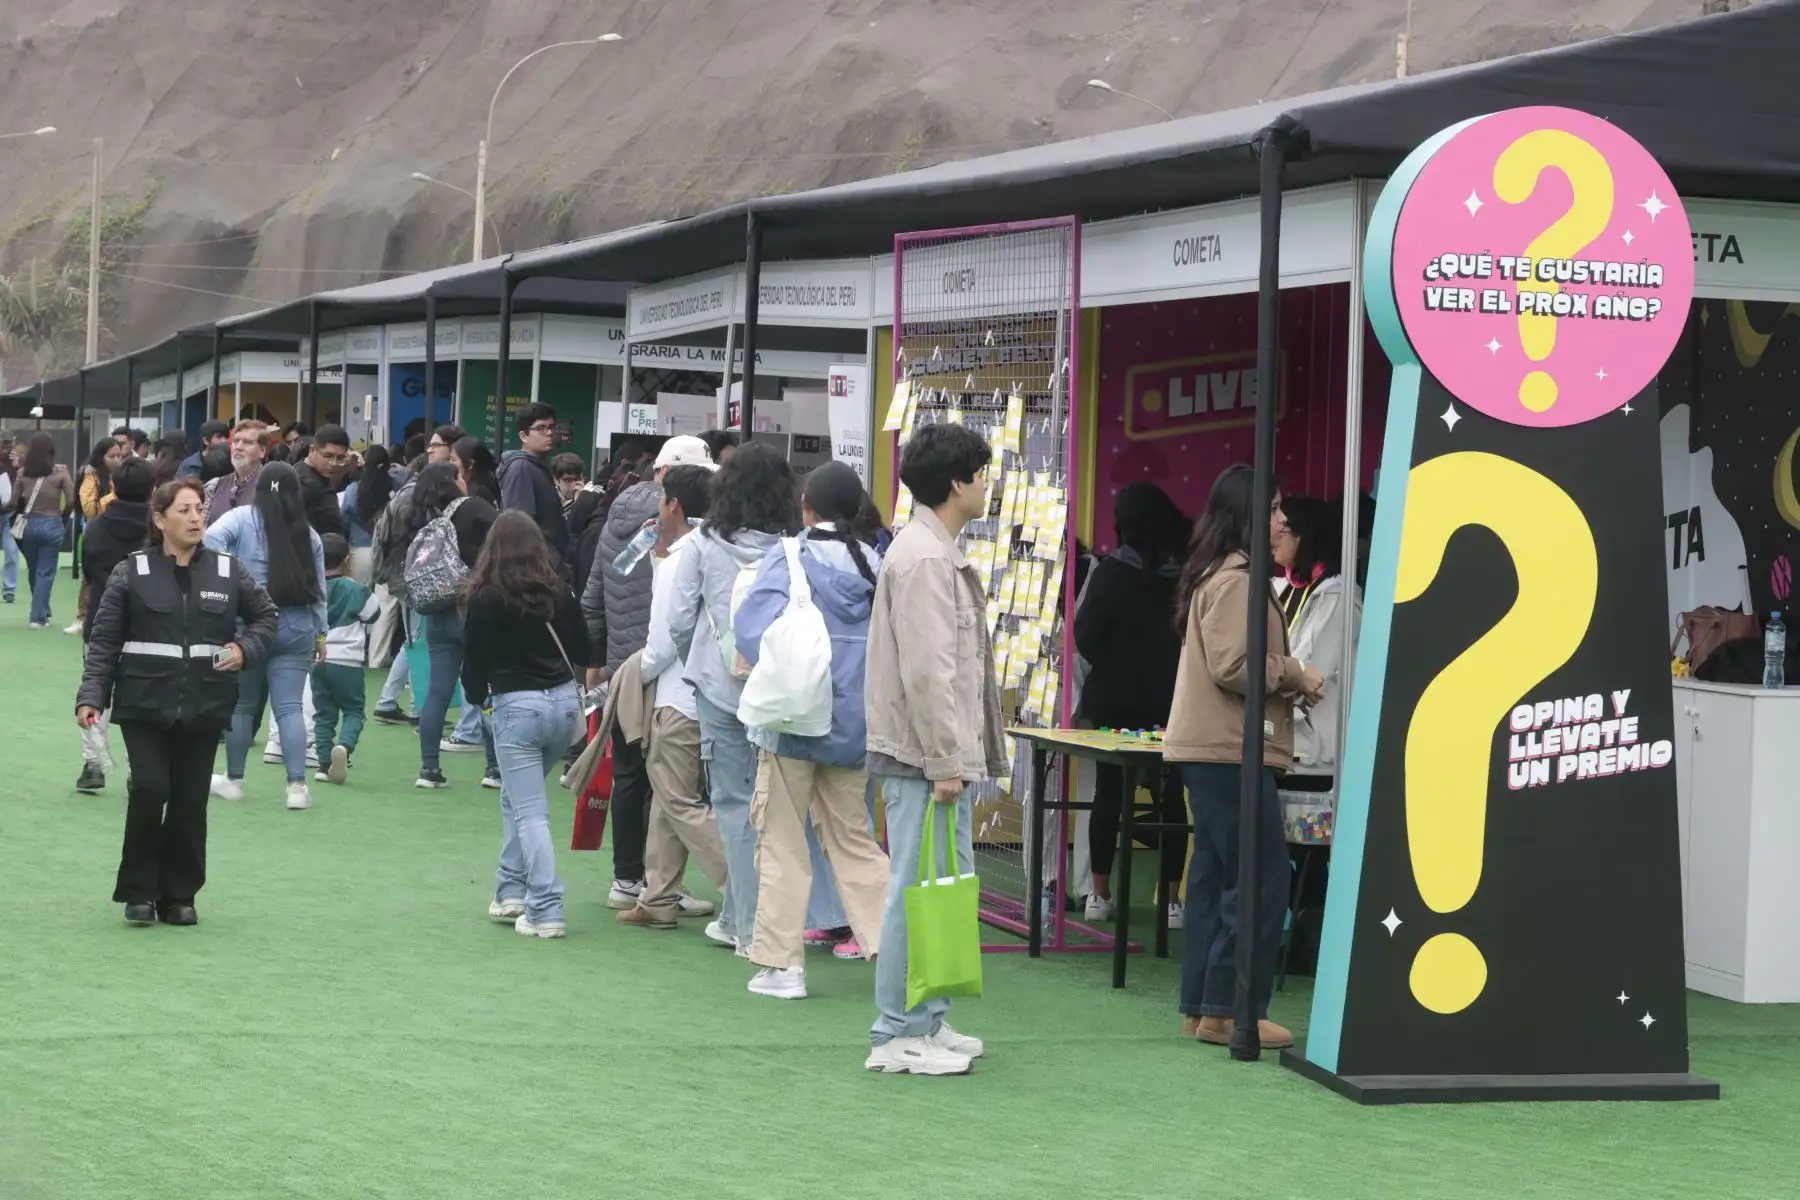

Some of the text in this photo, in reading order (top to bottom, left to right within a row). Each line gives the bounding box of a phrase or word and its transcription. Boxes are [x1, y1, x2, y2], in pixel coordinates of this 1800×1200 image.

[1173, 234, 1221, 266] COMETA
[1424, 249, 1664, 288] ¿QUÉ TE GUSTARÍA
[759, 285, 783, 305] ERSIDAD
[826, 286, 837, 306] DEL
[1424, 286, 1663, 322] VER EL PRÓX AÑO?
[687, 347, 704, 360] LA
[830, 379, 847, 393] UTP
[1168, 368, 1258, 418] LIVE
[630, 408, 645, 419] CE
[1664, 505, 1706, 570] TA
[1510, 689, 1632, 732] OPINA Y
[1508, 740, 1673, 790] UN PREMIO
